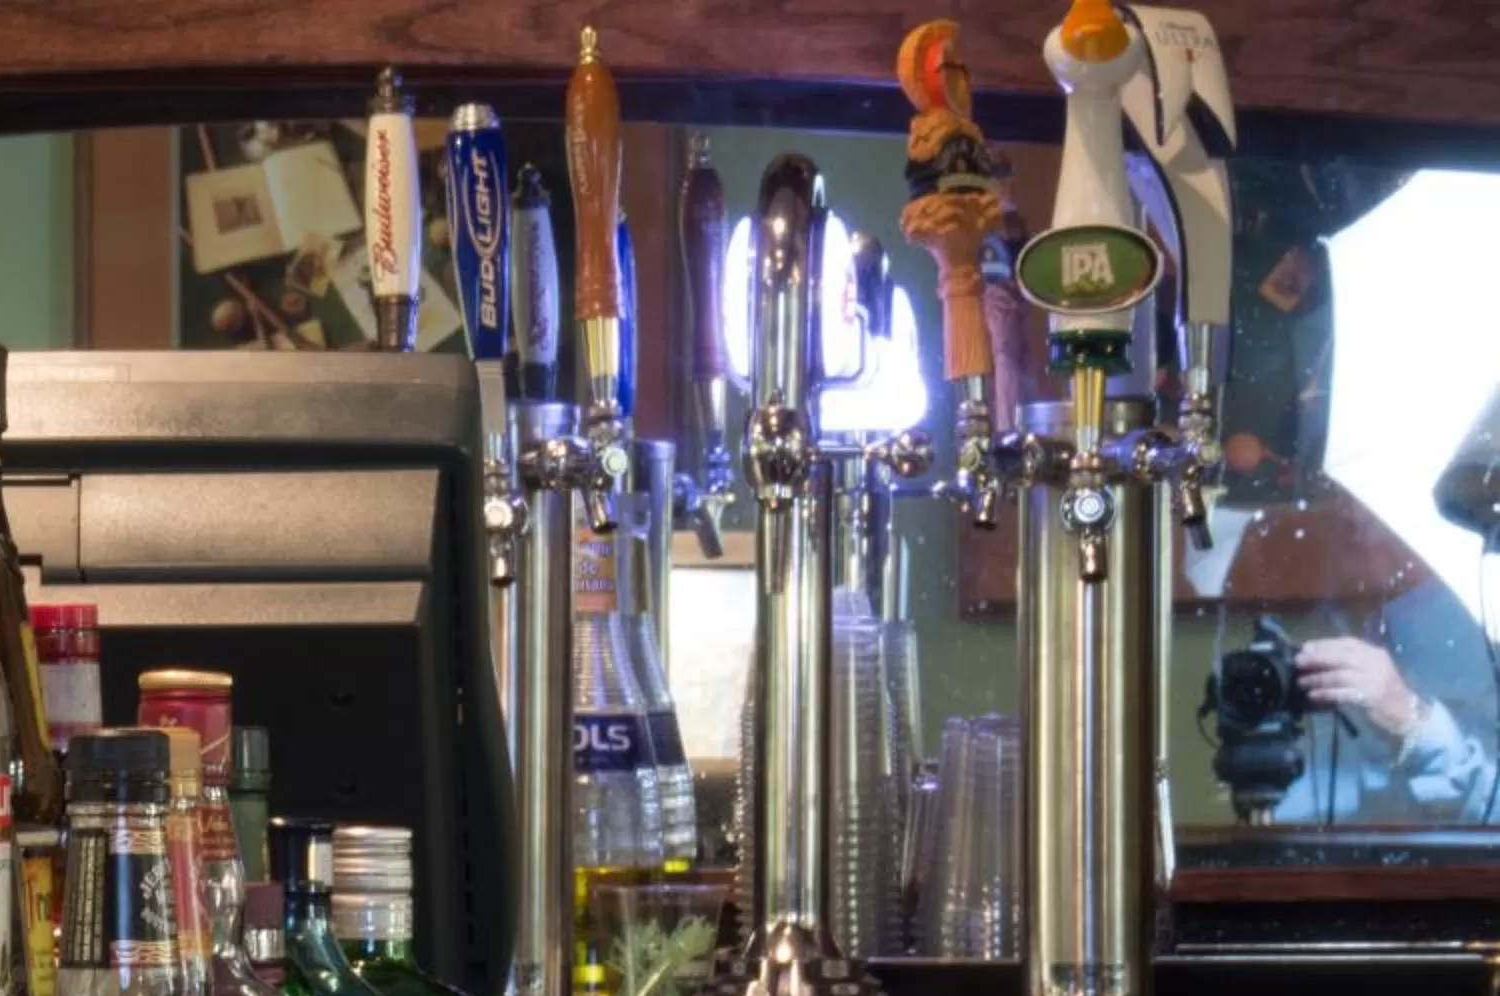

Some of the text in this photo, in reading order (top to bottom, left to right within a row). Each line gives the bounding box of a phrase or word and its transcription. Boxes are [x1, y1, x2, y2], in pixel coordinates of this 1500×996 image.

[372, 130, 399, 276] Budweiser
[470, 148, 498, 329] BUD LIGHT
[1060, 245, 1114, 290] IPA
[573, 722, 631, 752] OLS
